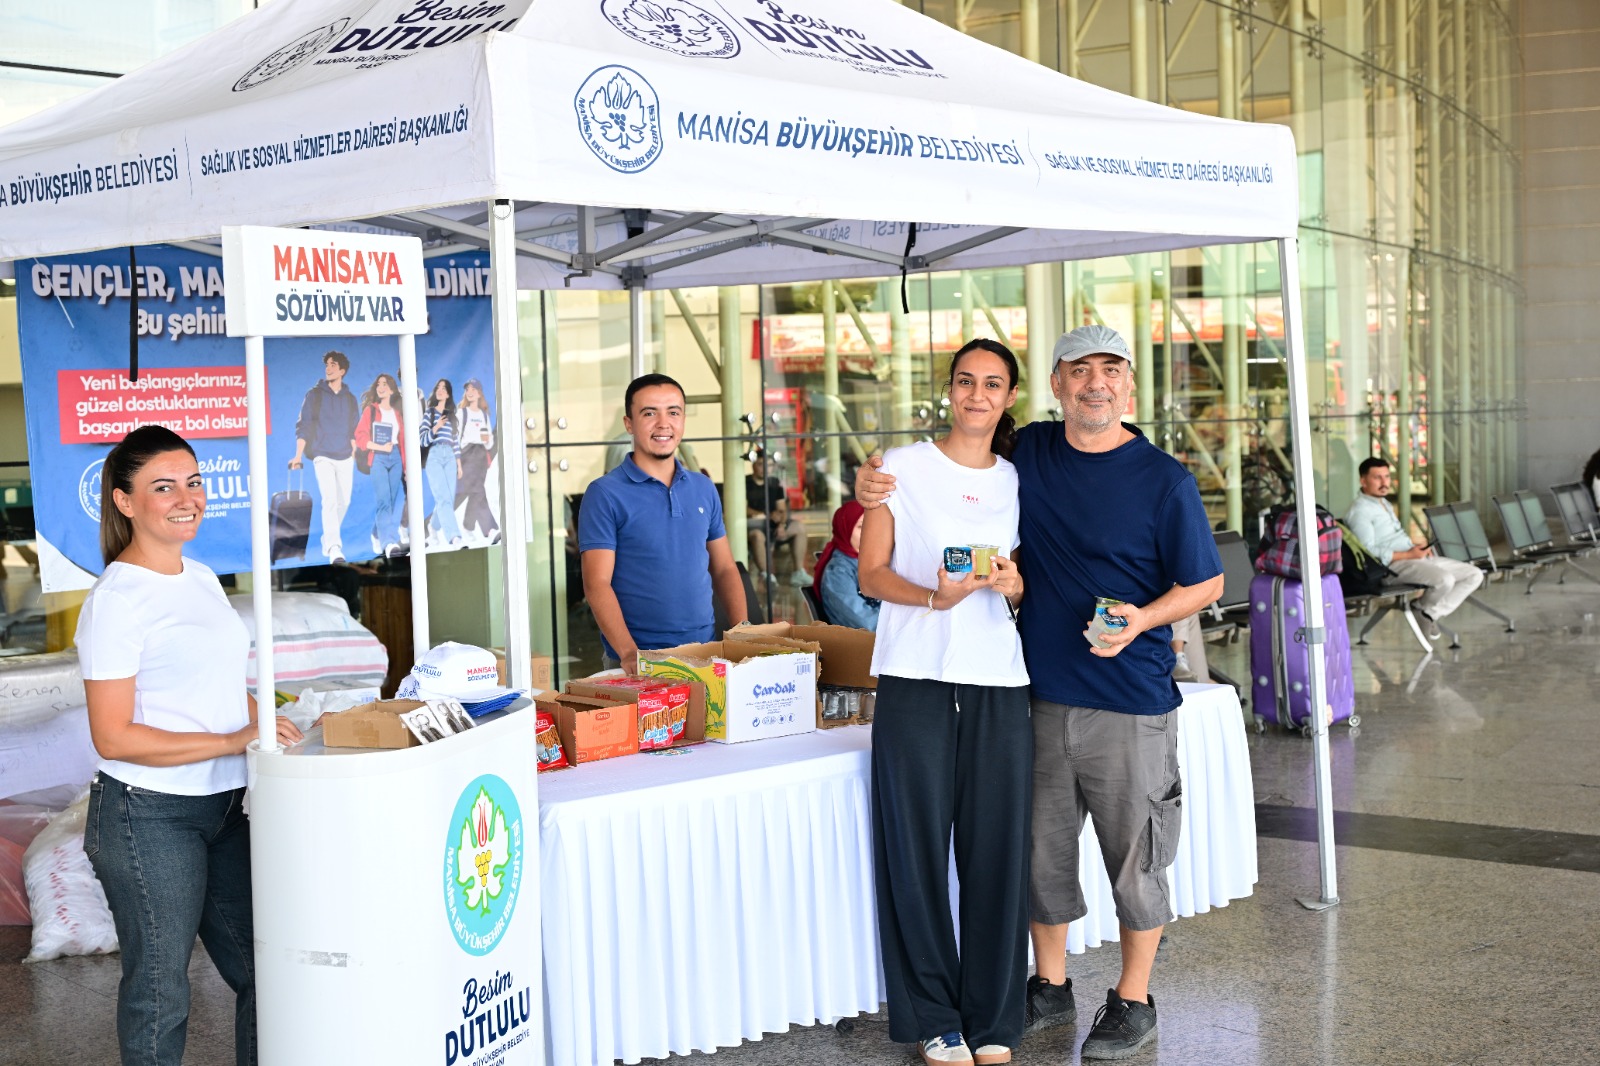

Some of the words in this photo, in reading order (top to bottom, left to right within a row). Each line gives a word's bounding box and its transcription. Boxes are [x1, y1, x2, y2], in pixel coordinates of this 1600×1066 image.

[395, 0, 506, 24] Besim
[757, 0, 865, 40] Besim
[743, 17, 934, 70] DUTLULU
[201, 148, 236, 176] SAĞLIK
[238, 148, 251, 170] VE
[252, 142, 292, 169] SOSYAL
[293, 134, 352, 162] HİZMETLER
[353, 117, 397, 151] DAİRESİ
[398, 104, 469, 146] BAŞKANLIĞI
[678, 110, 769, 147] MANİSA
[775, 116, 914, 159] BÜYÜKŞEHİR
[916, 135, 1025, 166] BELEDİYESİ
[10, 163, 93, 205] BÜYÜKŞEHİR
[95, 147, 179, 192] BELEDİYESİ
[1045, 150, 1082, 171] SAĞLIK
[1081, 156, 1098, 173] VE
[1096, 157, 1137, 177] SOSYAL
[1135, 156, 1186, 180] HİZMETLER
[1186, 160, 1221, 183] DAİRESİ
[1222, 163, 1274, 187] BAŞKANLIĞI
[273, 241, 403, 285] MANİSA'YA
[424, 258, 493, 297] LDİNİZ
[137, 308, 163, 336] Bu
[275, 288, 366, 323] SÖZÜMÜZ
[368, 295, 405, 323] VAR
[80, 374, 116, 391] Yeni
[75, 395, 123, 417] güzel
[125, 394, 231, 413] dostluklarınız
[185, 415, 210, 431] bol
[199, 455, 241, 474] esim
[201, 511, 227, 519] AŞKANI
[753, 681, 796, 699] Çardak
[446, 846, 457, 920] MANİSA
[454, 916, 506, 952] BÜYÜKŞEHİR
[503, 818, 521, 921] BELEDİYESİ
[462, 969, 513, 1019] Besim
[445, 986, 531, 1066] DUTLULU
[507, 1029, 530, 1050] BELEDİYE
